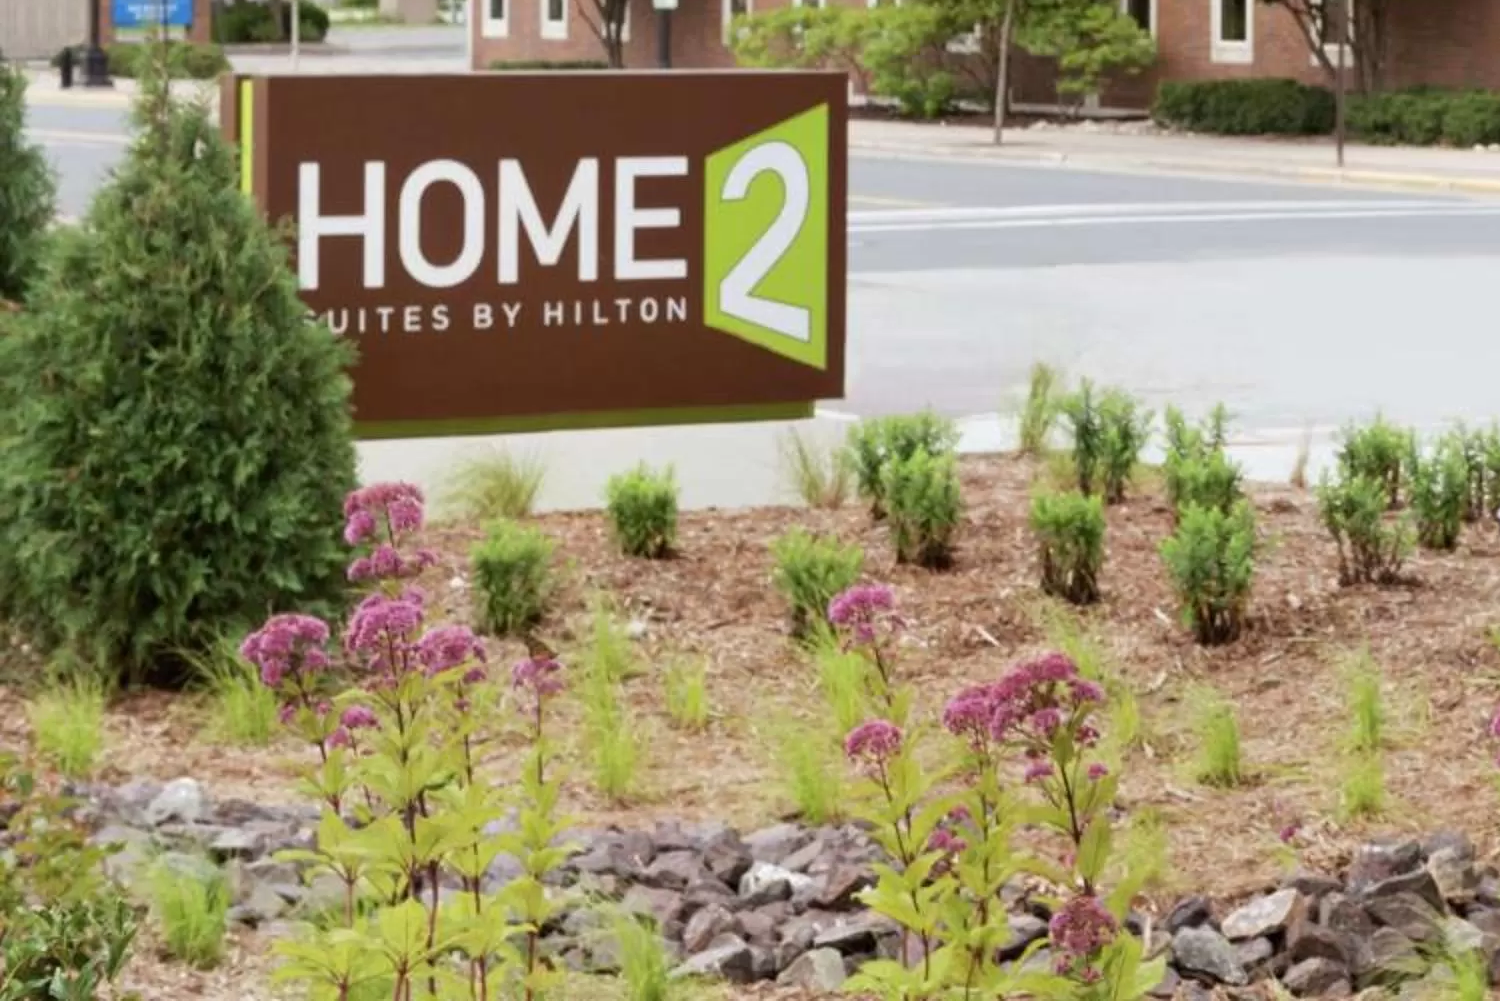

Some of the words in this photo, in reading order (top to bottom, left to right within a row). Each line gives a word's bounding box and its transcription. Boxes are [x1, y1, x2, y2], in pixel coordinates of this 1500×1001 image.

[297, 156, 688, 290] HOME
[718, 141, 811, 342] 2
[473, 301, 522, 330] BY
[543, 296, 688, 326] HILTON
